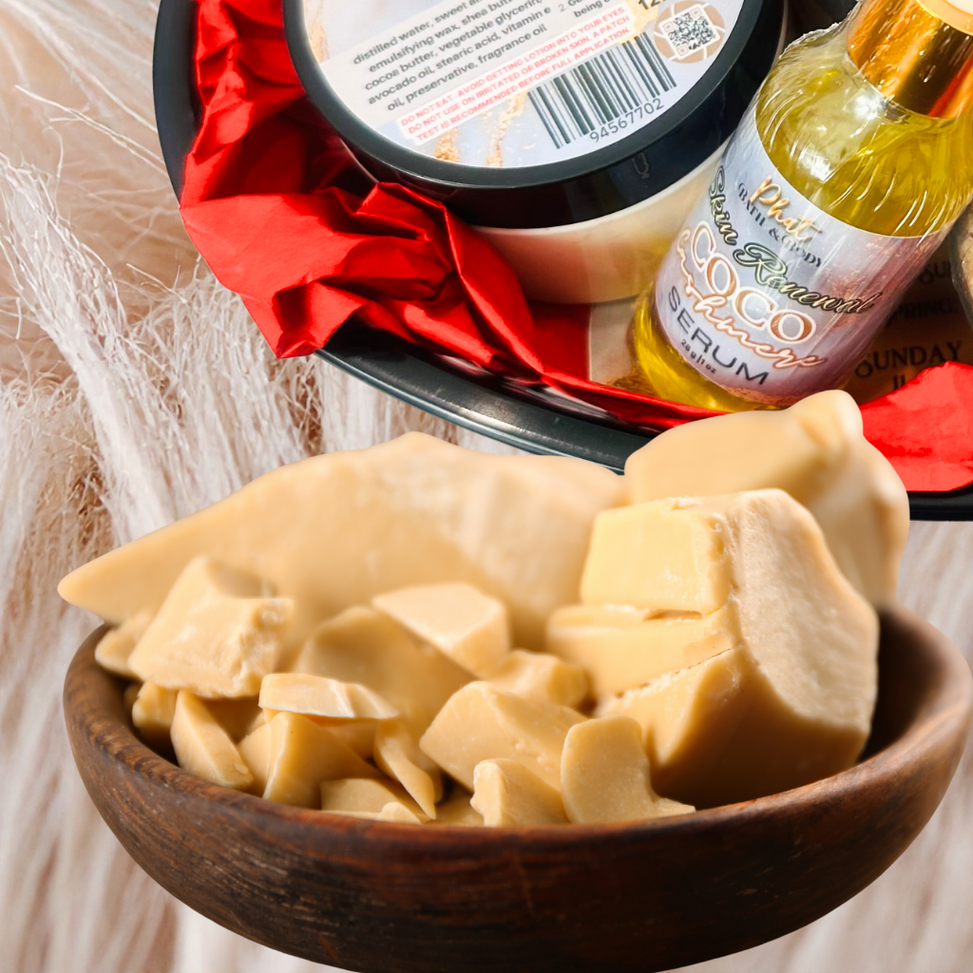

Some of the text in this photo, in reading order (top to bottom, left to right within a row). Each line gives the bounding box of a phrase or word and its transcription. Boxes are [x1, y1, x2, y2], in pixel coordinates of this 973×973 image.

[353, 37, 398, 64] distilled
[398, 21, 434, 41] water,
[434, 2, 467, 23] sweet
[369, 36, 434, 72] emulsifying
[434, 24, 461, 39] wax,
[461, 9, 488, 25] shea
[573, 0, 603, 18] being
[365, 69, 399, 90] cocoa
[399, 50, 438, 73] butter,
[438, 21, 493, 52] vegetable
[369, 76, 417, 104] avocado
[418, 66, 436, 79] oil,
[436, 47, 474, 69] stearic
[474, 32, 502, 50] acid,
[501, 11, 543, 35] vitamin
[387, 24, 547, 111] oil, preservative, fragrance oil
[401, 7, 625, 126] DO NOT EAT. AVOID GETTING LOTION INTO YOUR EYES.
[408, 123, 422, 134] DO
[423, 113, 440, 126] NOT
[443, 103, 460, 115] USE
[461, 96, 476, 106] ON
[476, 72, 520, 98] IRRITATED
[521, 65, 534, 75] OR
[534, 47, 569, 68] BROKEN
[569, 36, 592, 50] SKIN.
[600, 16, 630, 34] PATCH
[416, 27, 631, 140] TEST IS RECOMMENDED BEFORE FULL APPLICATION.
[590, 99, 664, 142] 94567702
[708, 166, 883, 313] Skin Renewal
[750, 174, 823, 240] Phat
[677, 229, 827, 370] Cashmere
[690, 220, 816, 343] COCO
[668, 285, 769, 386] SERUM
[681, 339, 691, 351] 28
[706, 364, 717, 374] oz
